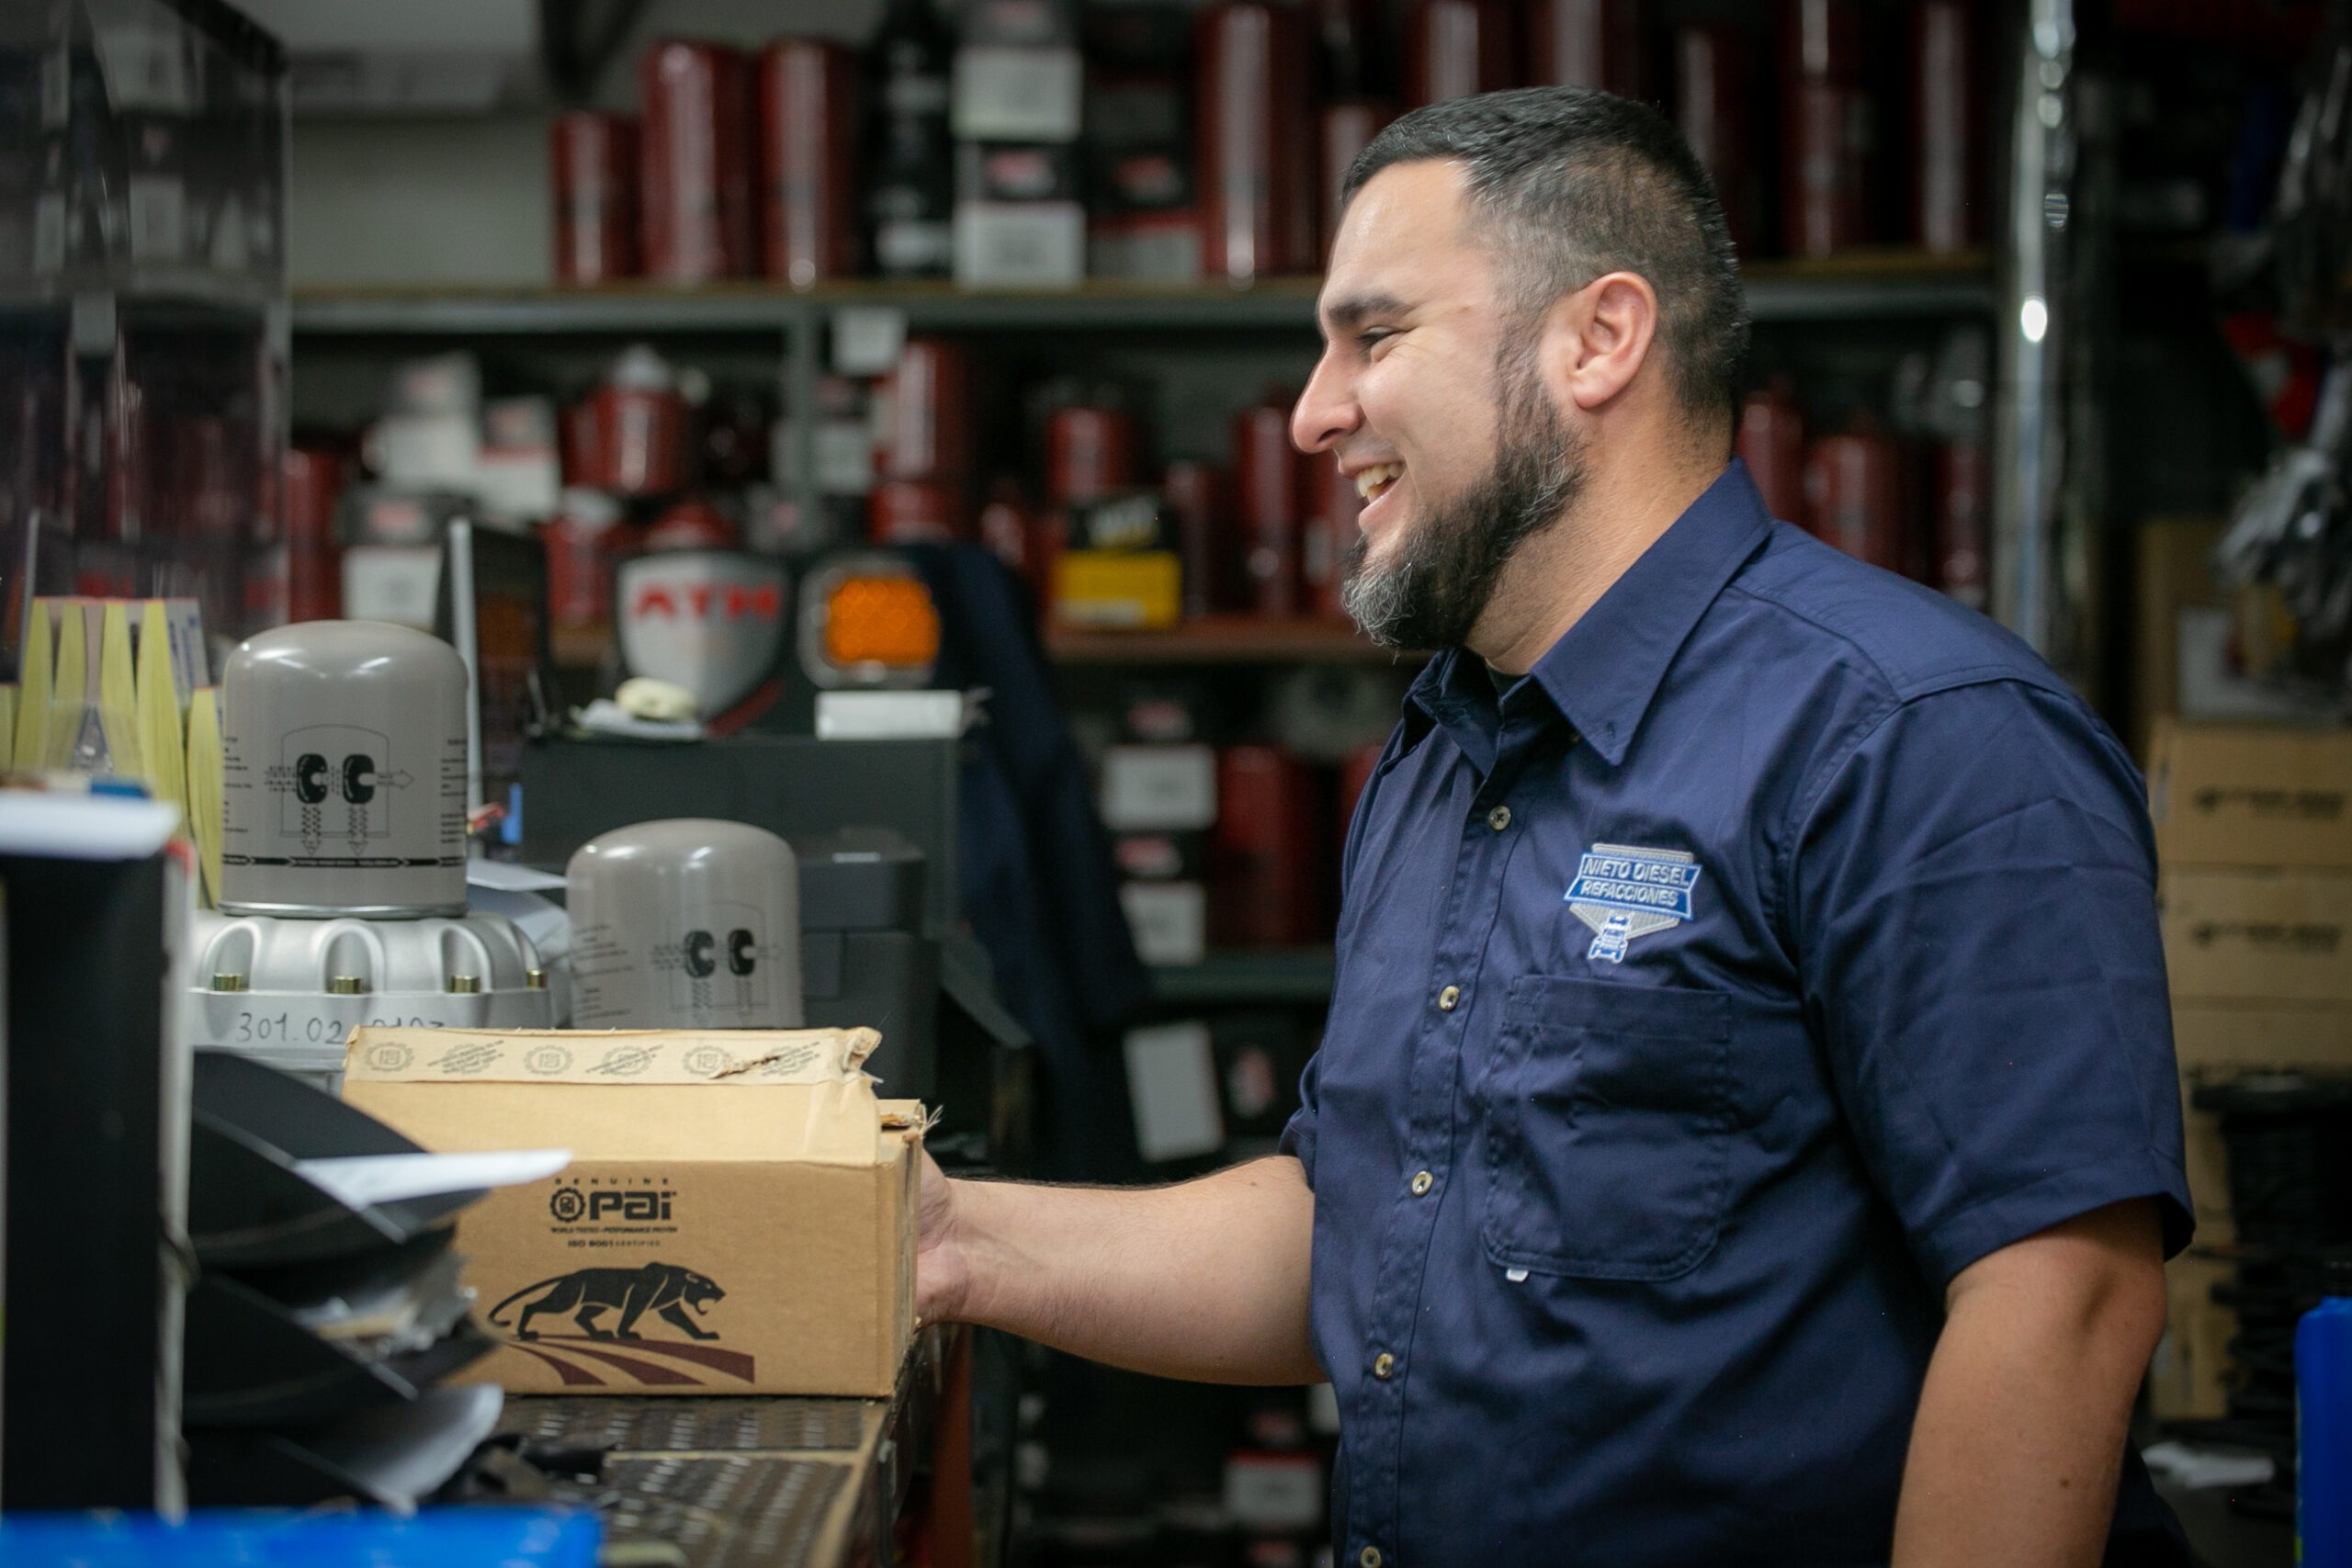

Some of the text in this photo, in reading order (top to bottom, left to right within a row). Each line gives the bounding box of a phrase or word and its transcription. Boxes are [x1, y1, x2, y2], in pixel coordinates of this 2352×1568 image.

[1582, 858, 1690, 886] NIETO DIESEL
[1579, 879, 1679, 908] REFACCIONES
